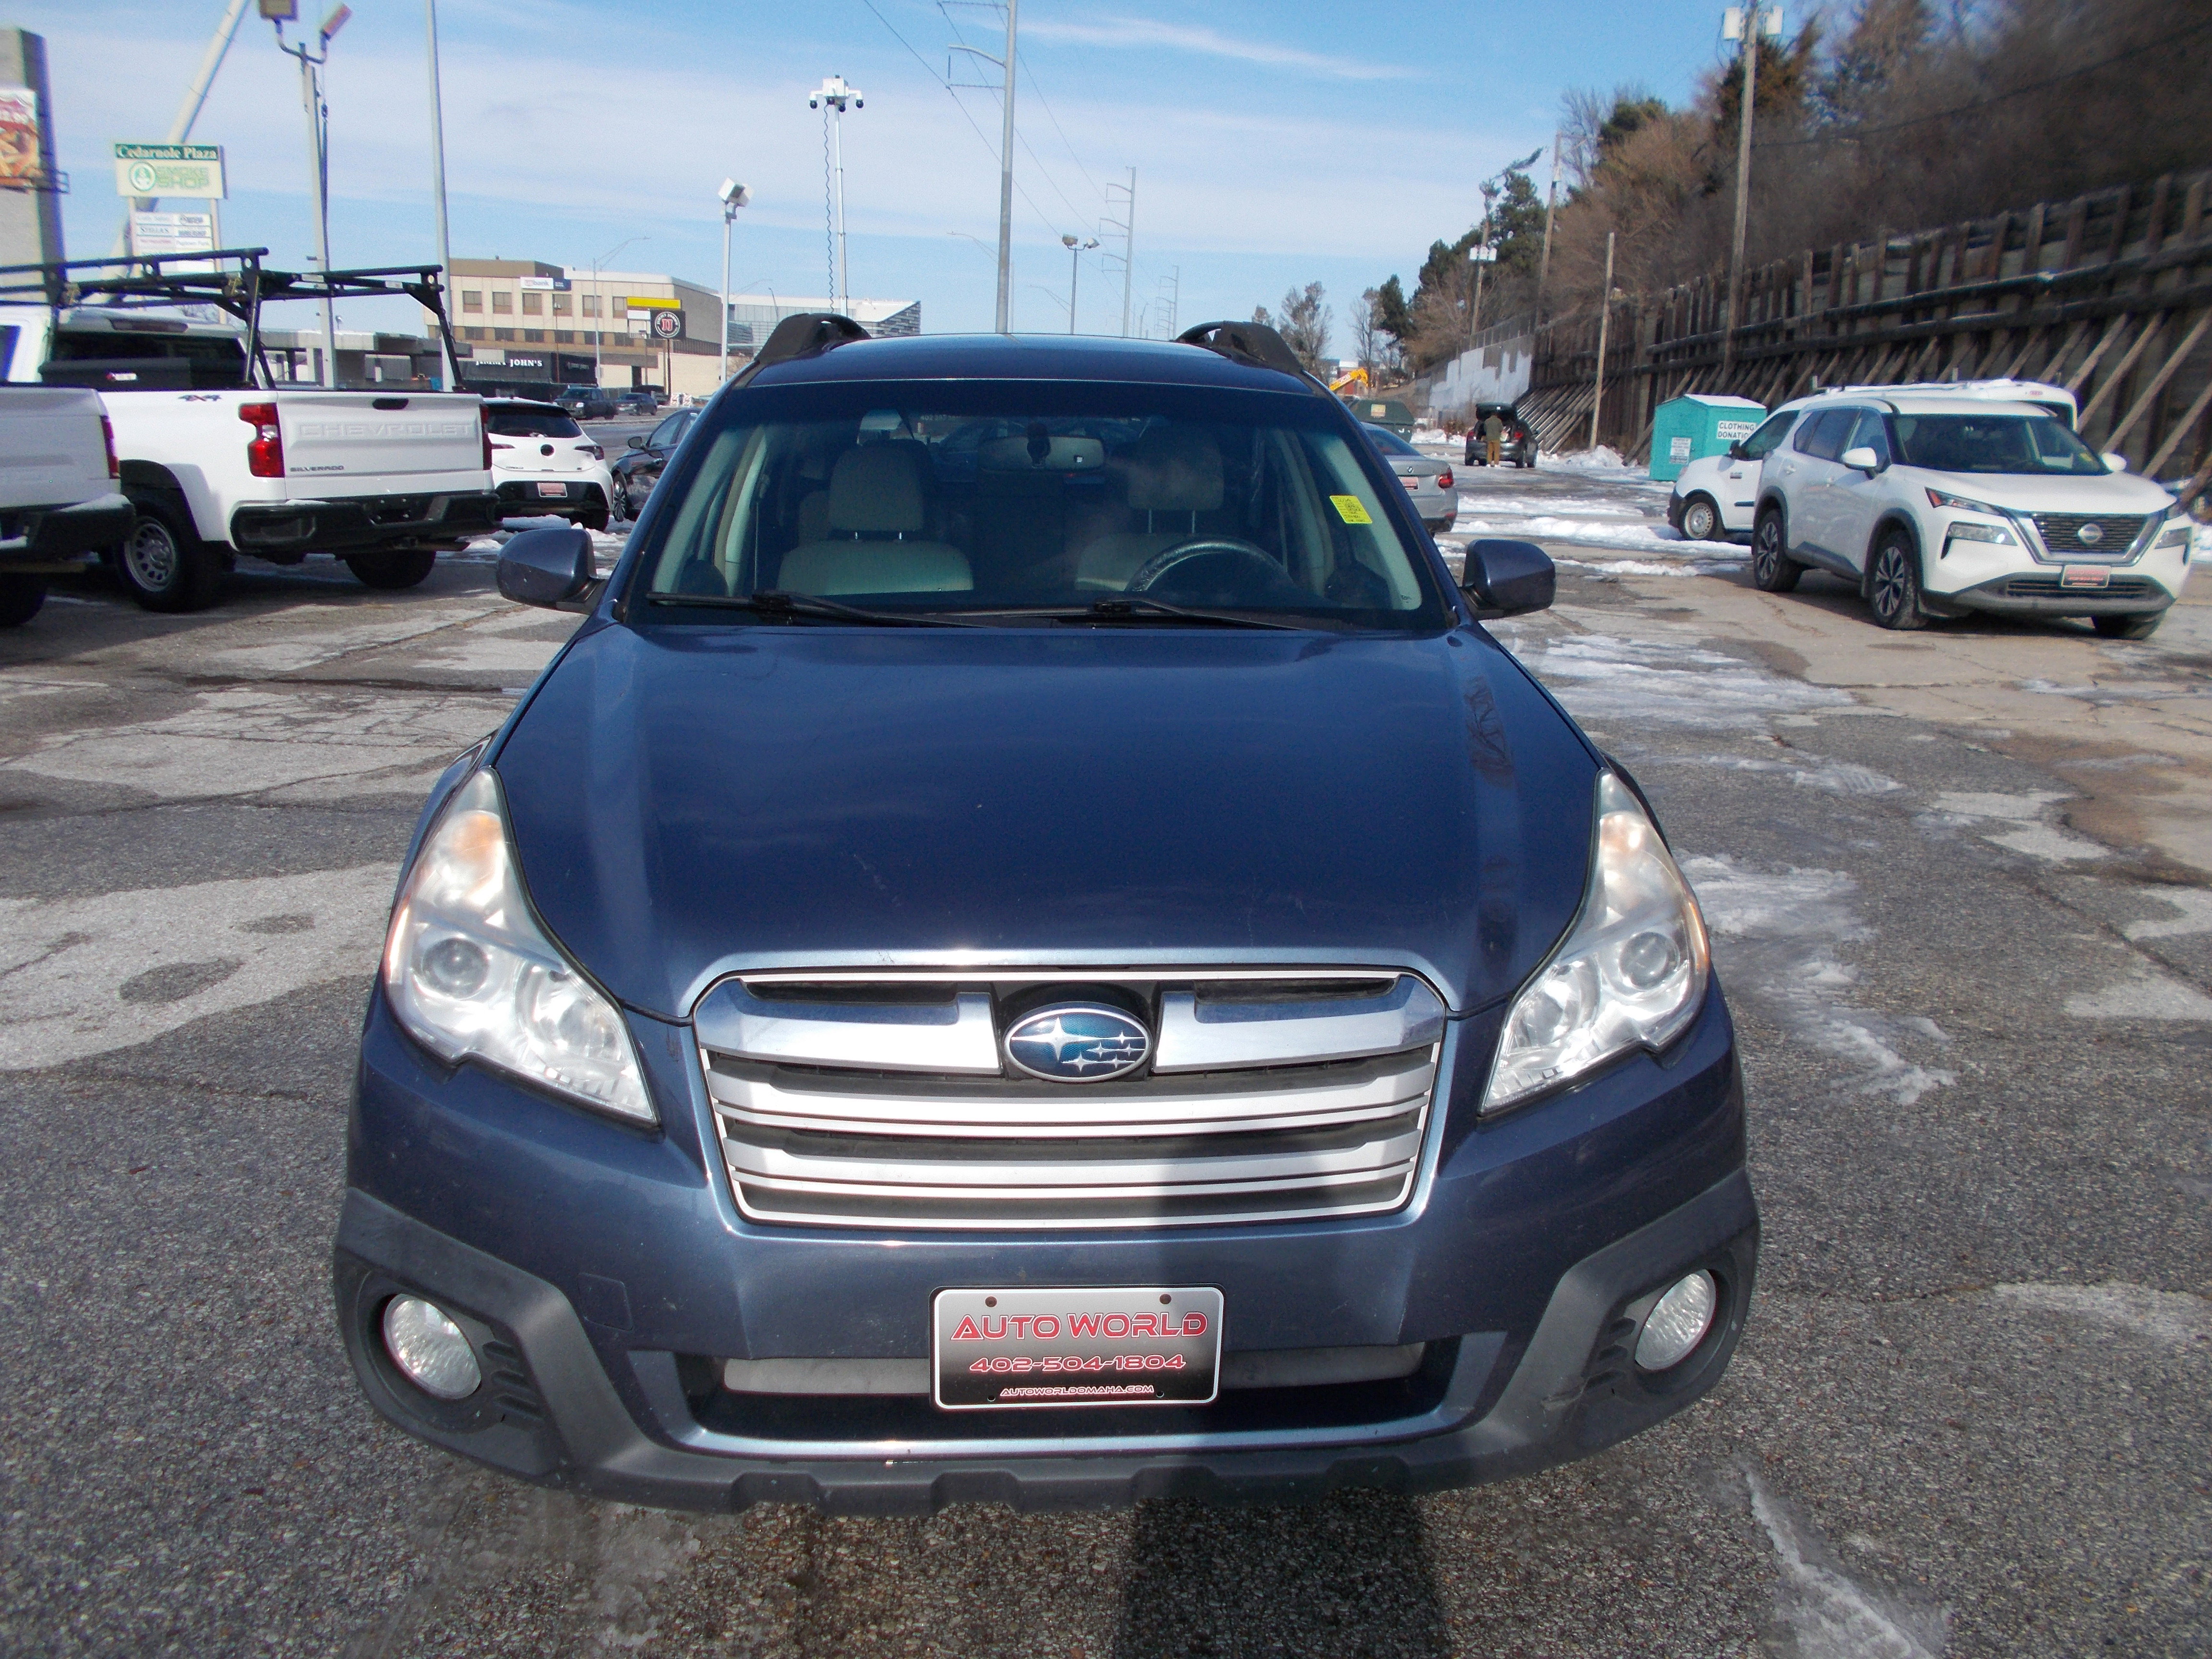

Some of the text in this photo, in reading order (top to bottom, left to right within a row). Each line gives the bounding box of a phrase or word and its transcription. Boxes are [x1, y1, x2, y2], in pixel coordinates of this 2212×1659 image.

[183, 147, 218, 159] Plaza
[156, 177, 209, 188] SHOP
[510, 359, 542, 367] JOHN'S
[300, 422, 472, 438] CHEVROLET
[1719, 422, 1755, 431] CLOTHING
[1718, 431, 1748, 439] DONATIO
[950, 1311, 1208, 1340] AUTO WORLD
[969, 1354, 1187, 1373] 402-504-1804
[999, 1384, 1154, 1396] AUTOWORLDOMAHA.COM
